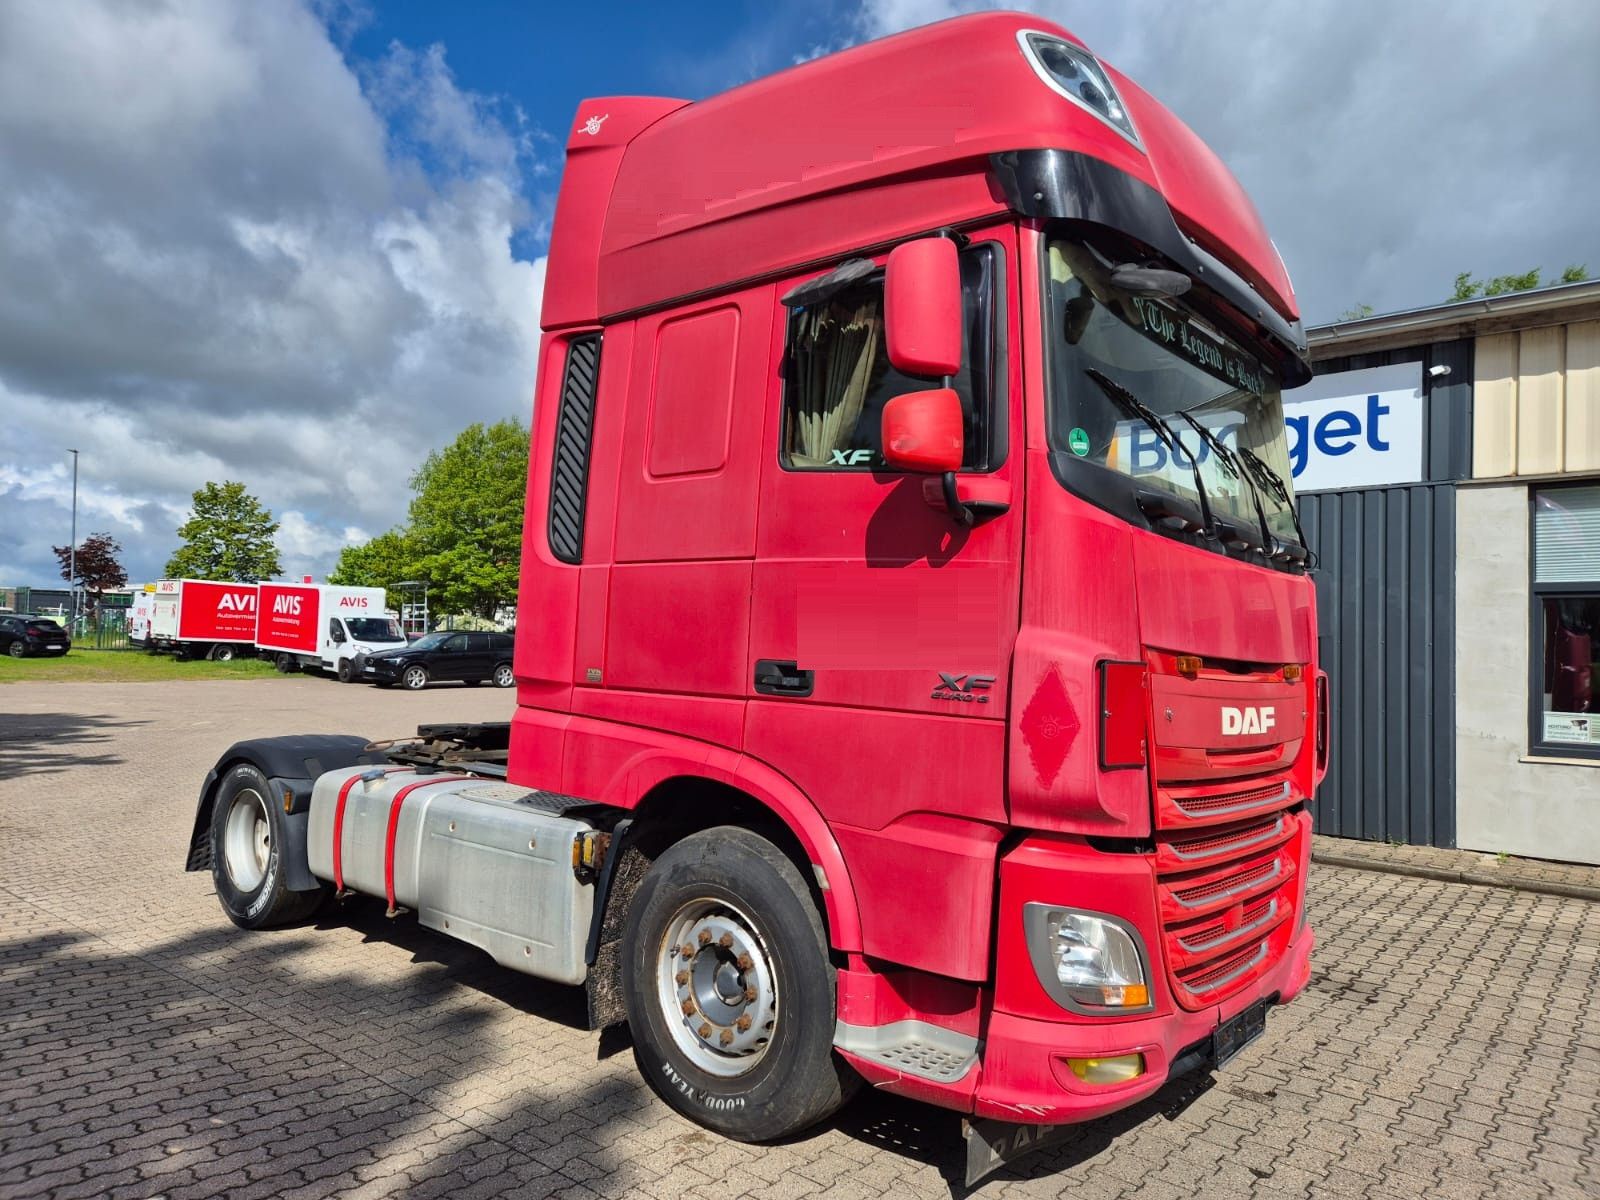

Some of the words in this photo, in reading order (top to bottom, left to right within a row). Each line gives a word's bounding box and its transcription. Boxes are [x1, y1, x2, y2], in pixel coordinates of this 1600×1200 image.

[1178, 320, 1222, 370] Legend
[1225, 357, 1235, 378] is
[825, 449, 875, 465] XF
[162, 583, 174, 592] AVIS
[217, 593, 255, 611] AVI
[272, 594, 301, 615] AVIS
[339, 597, 368, 607] AVIS
[933, 672, 997, 692] XF
[931, 691, 974, 702] EURO
[977, 694, 989, 703] 6
[1221, 706, 1275, 735] DAF
